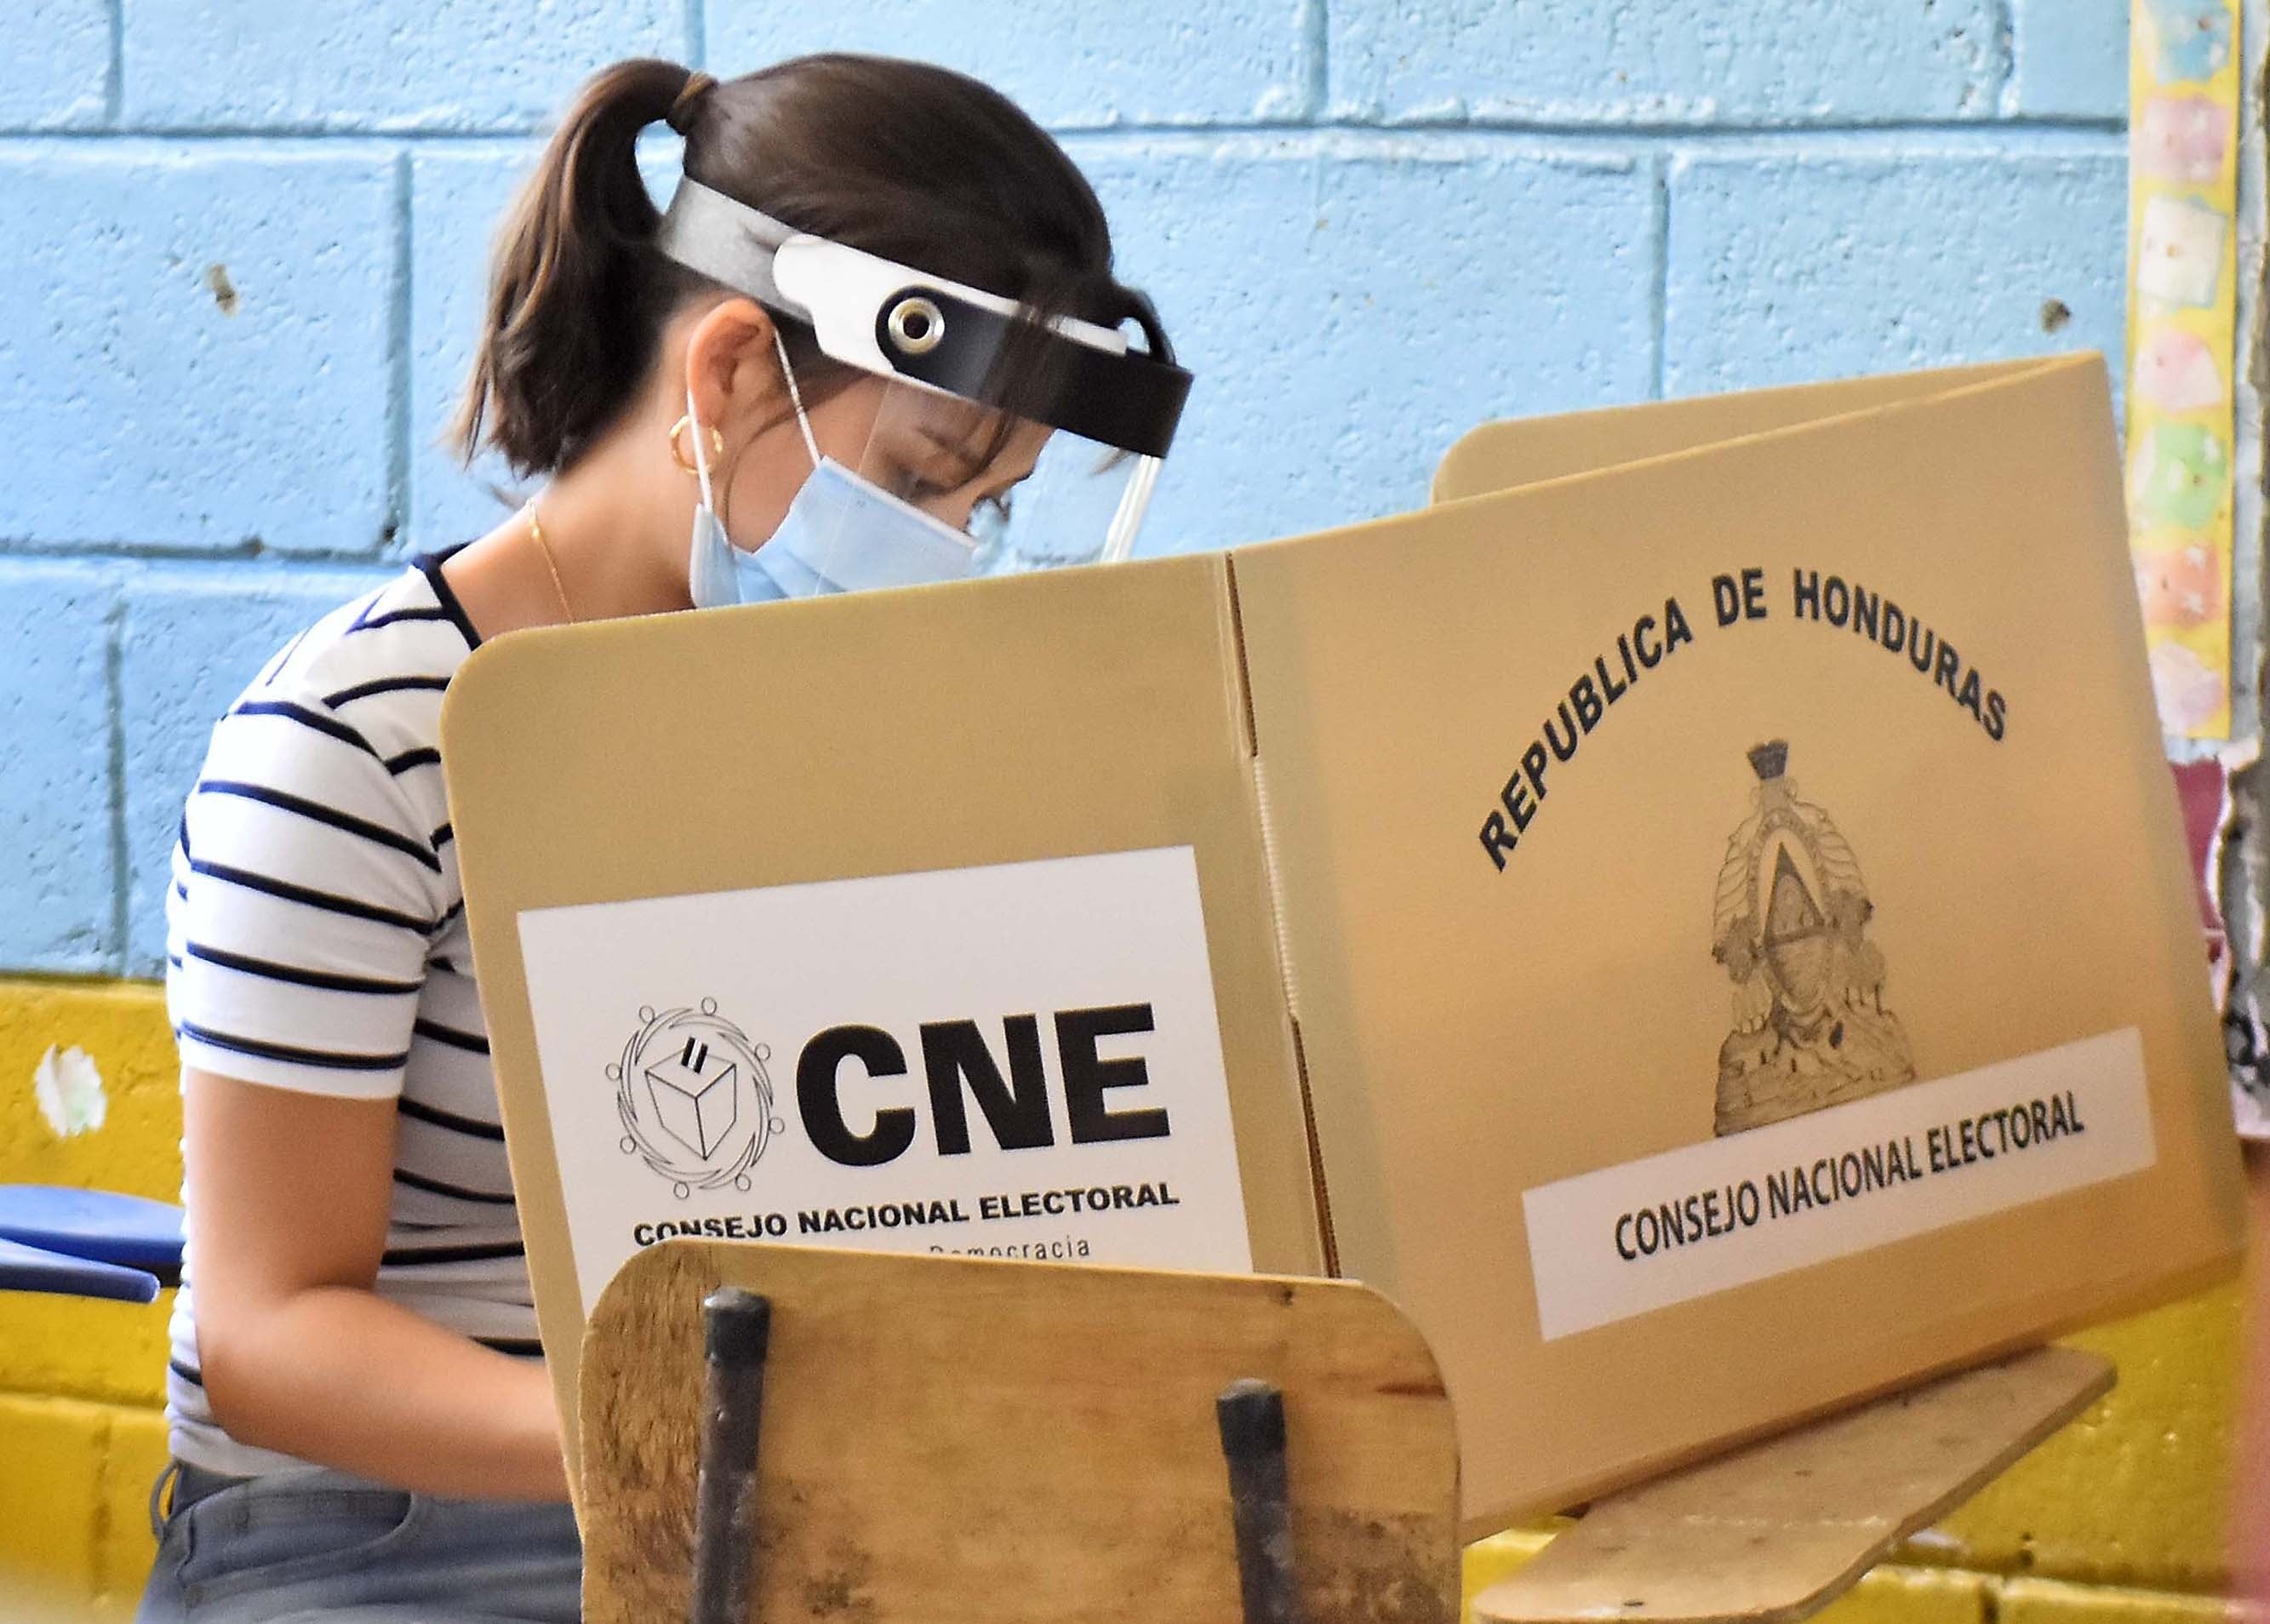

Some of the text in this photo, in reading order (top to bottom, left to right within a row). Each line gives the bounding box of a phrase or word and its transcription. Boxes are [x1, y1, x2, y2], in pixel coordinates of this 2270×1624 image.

[1478, 567, 2007, 873] REPUBLICA DE HONDURAS
[795, 1002, 1171, 1168] CNE
[633, 1182, 1180, 1247] CONSEJO NACIONAL ELECTORAL
[1615, 1090, 2085, 1262] CONSEJO NACIONAL ELECTORAL
